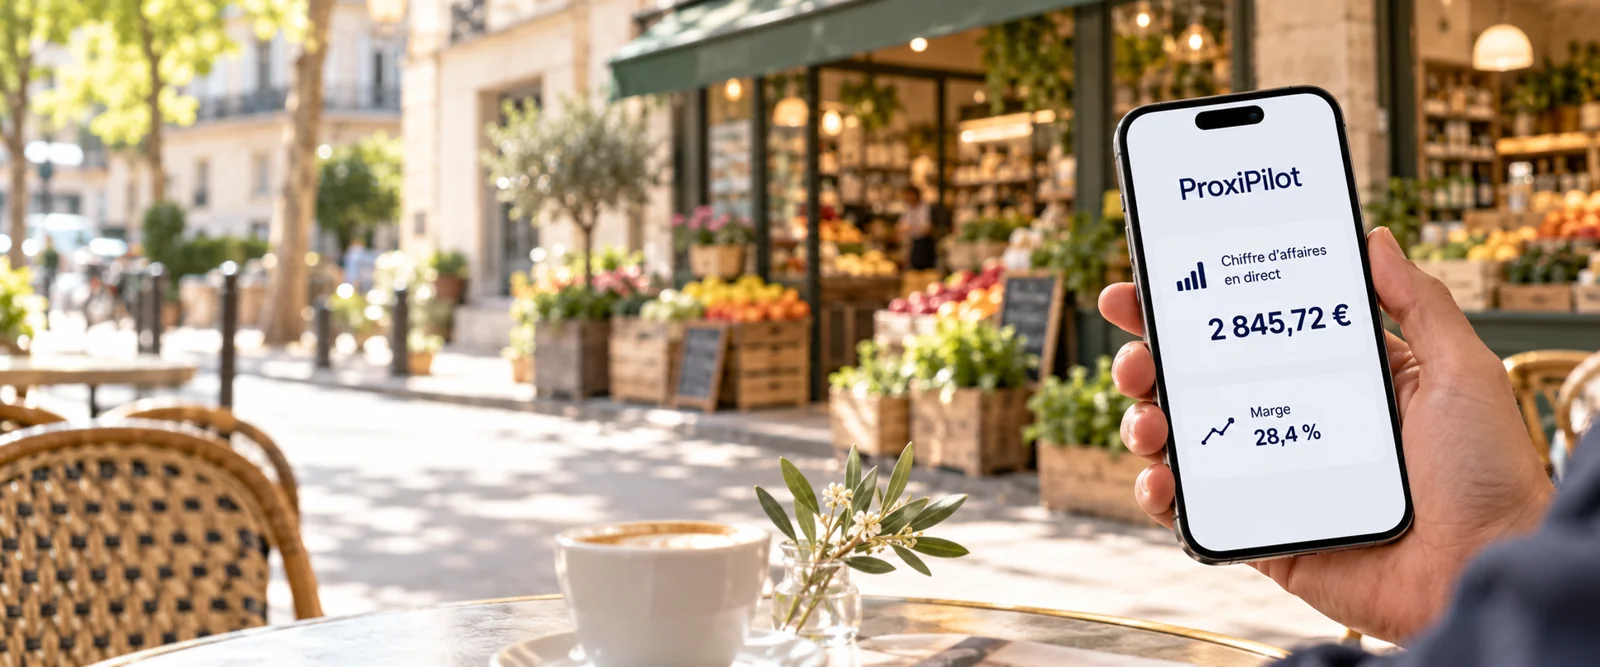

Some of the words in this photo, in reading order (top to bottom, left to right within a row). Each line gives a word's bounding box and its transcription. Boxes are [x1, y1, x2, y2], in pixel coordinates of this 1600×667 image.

[1178, 166, 1303, 201] ProxiPilot
[1220, 251, 1266, 267] Chiffre
[1268, 245, 1328, 262] d’affaires
[1224, 275, 1241, 286] en
[1243, 268, 1282, 284] direct
[1208, 317, 1227, 342] 2
[1232, 306, 1327, 339] 845,72
[1331, 303, 1352, 327] €
[1250, 404, 1291, 419] Marge
[1253, 425, 1299, 447] 28,4
[1301, 423, 1322, 441] %
